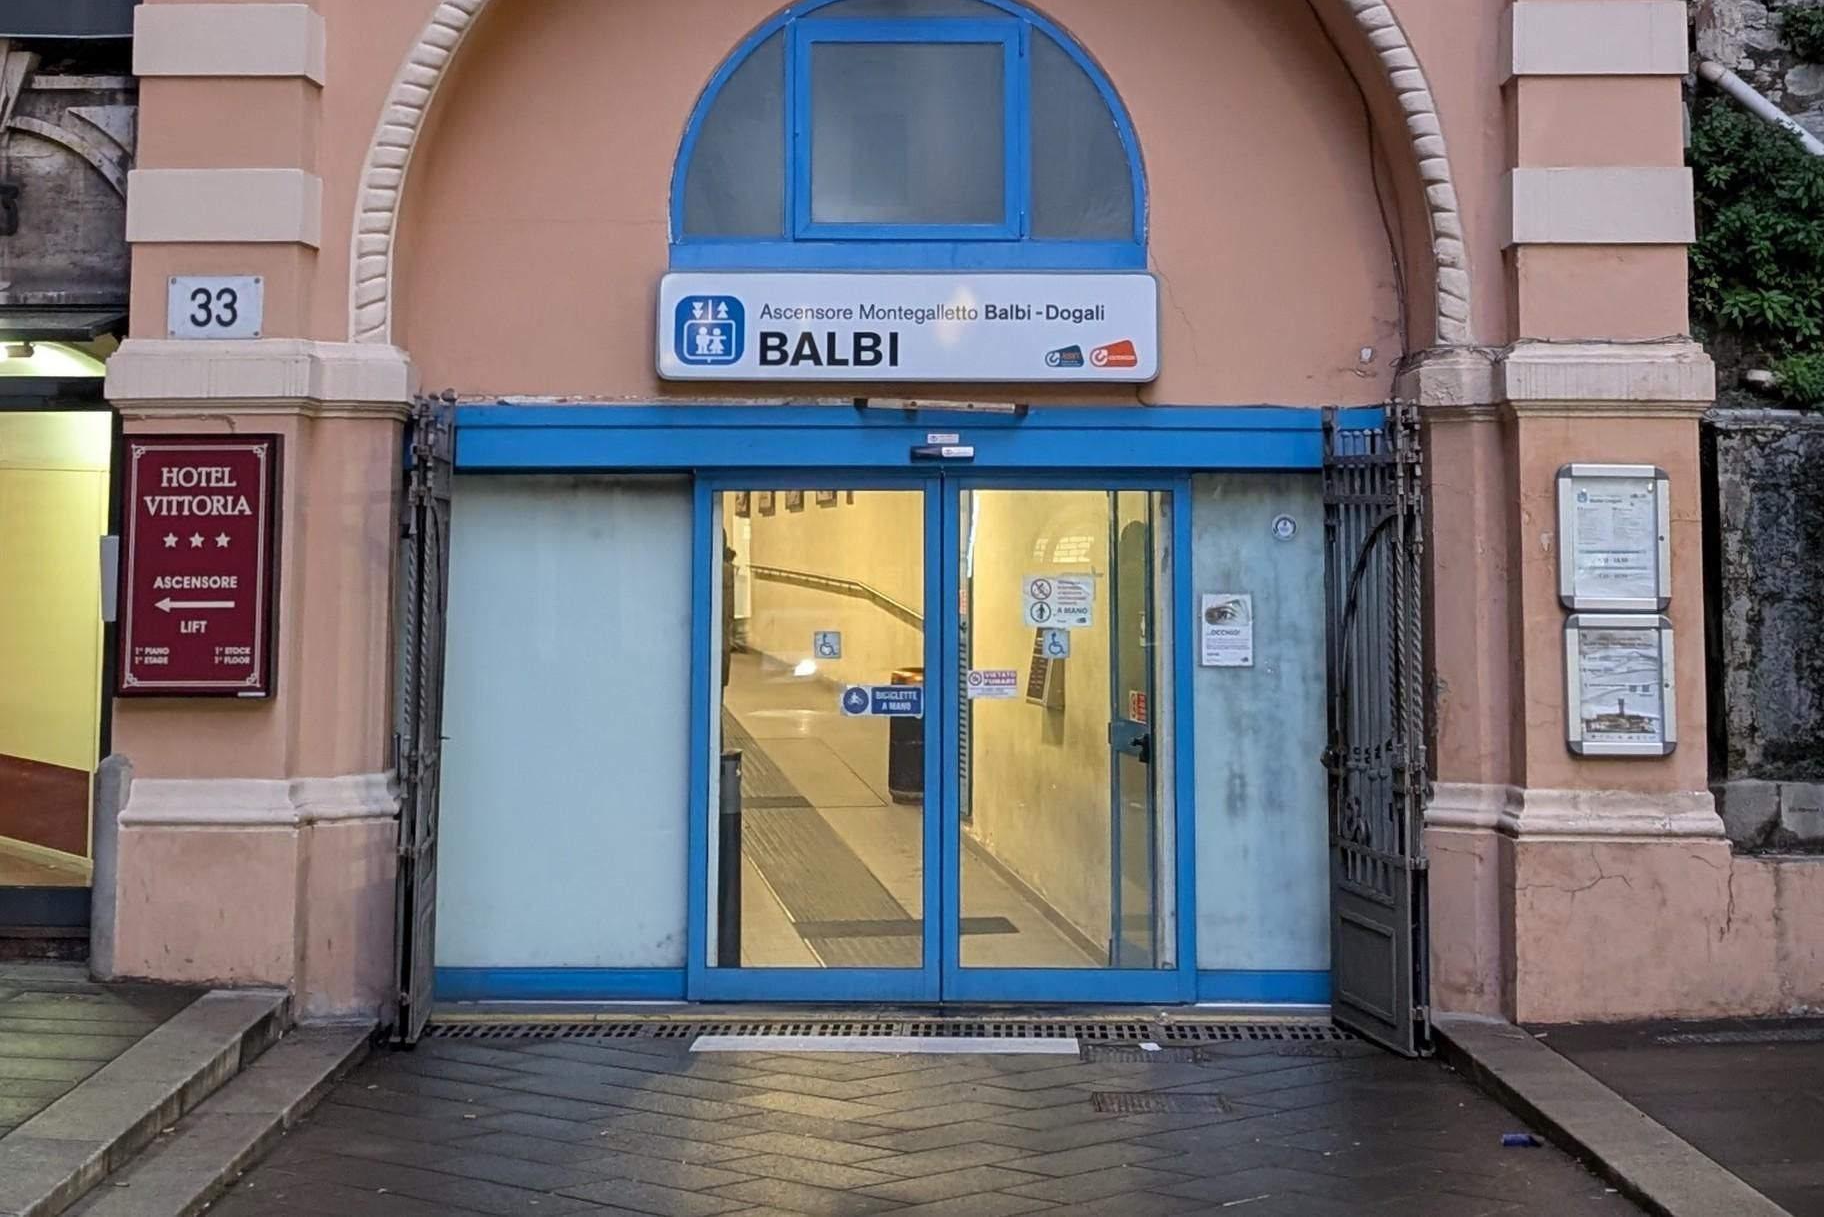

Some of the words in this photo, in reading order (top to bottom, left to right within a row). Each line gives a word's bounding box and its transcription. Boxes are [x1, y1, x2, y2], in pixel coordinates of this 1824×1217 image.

[190, 287, 238, 328] 33
[760, 304, 853, 320] Ascensore
[859, 304, 978, 324] Montegalletto
[759, 331, 899, 367] BALBI
[160, 466, 237, 487] HOTEL
[143, 494, 253, 516] VITTORIA
[153, 575, 238, 589] ASCENSORE
[180, 620, 207, 634] LIFT
[144, 646, 170, 655] PIANO
[224, 646, 251, 655] STOCK
[223, 655, 251, 665] FLOOR
[875, 691, 918, 701] BICICLETTE
[881, 702, 888, 710] A
[889, 701, 912, 711] MANO
